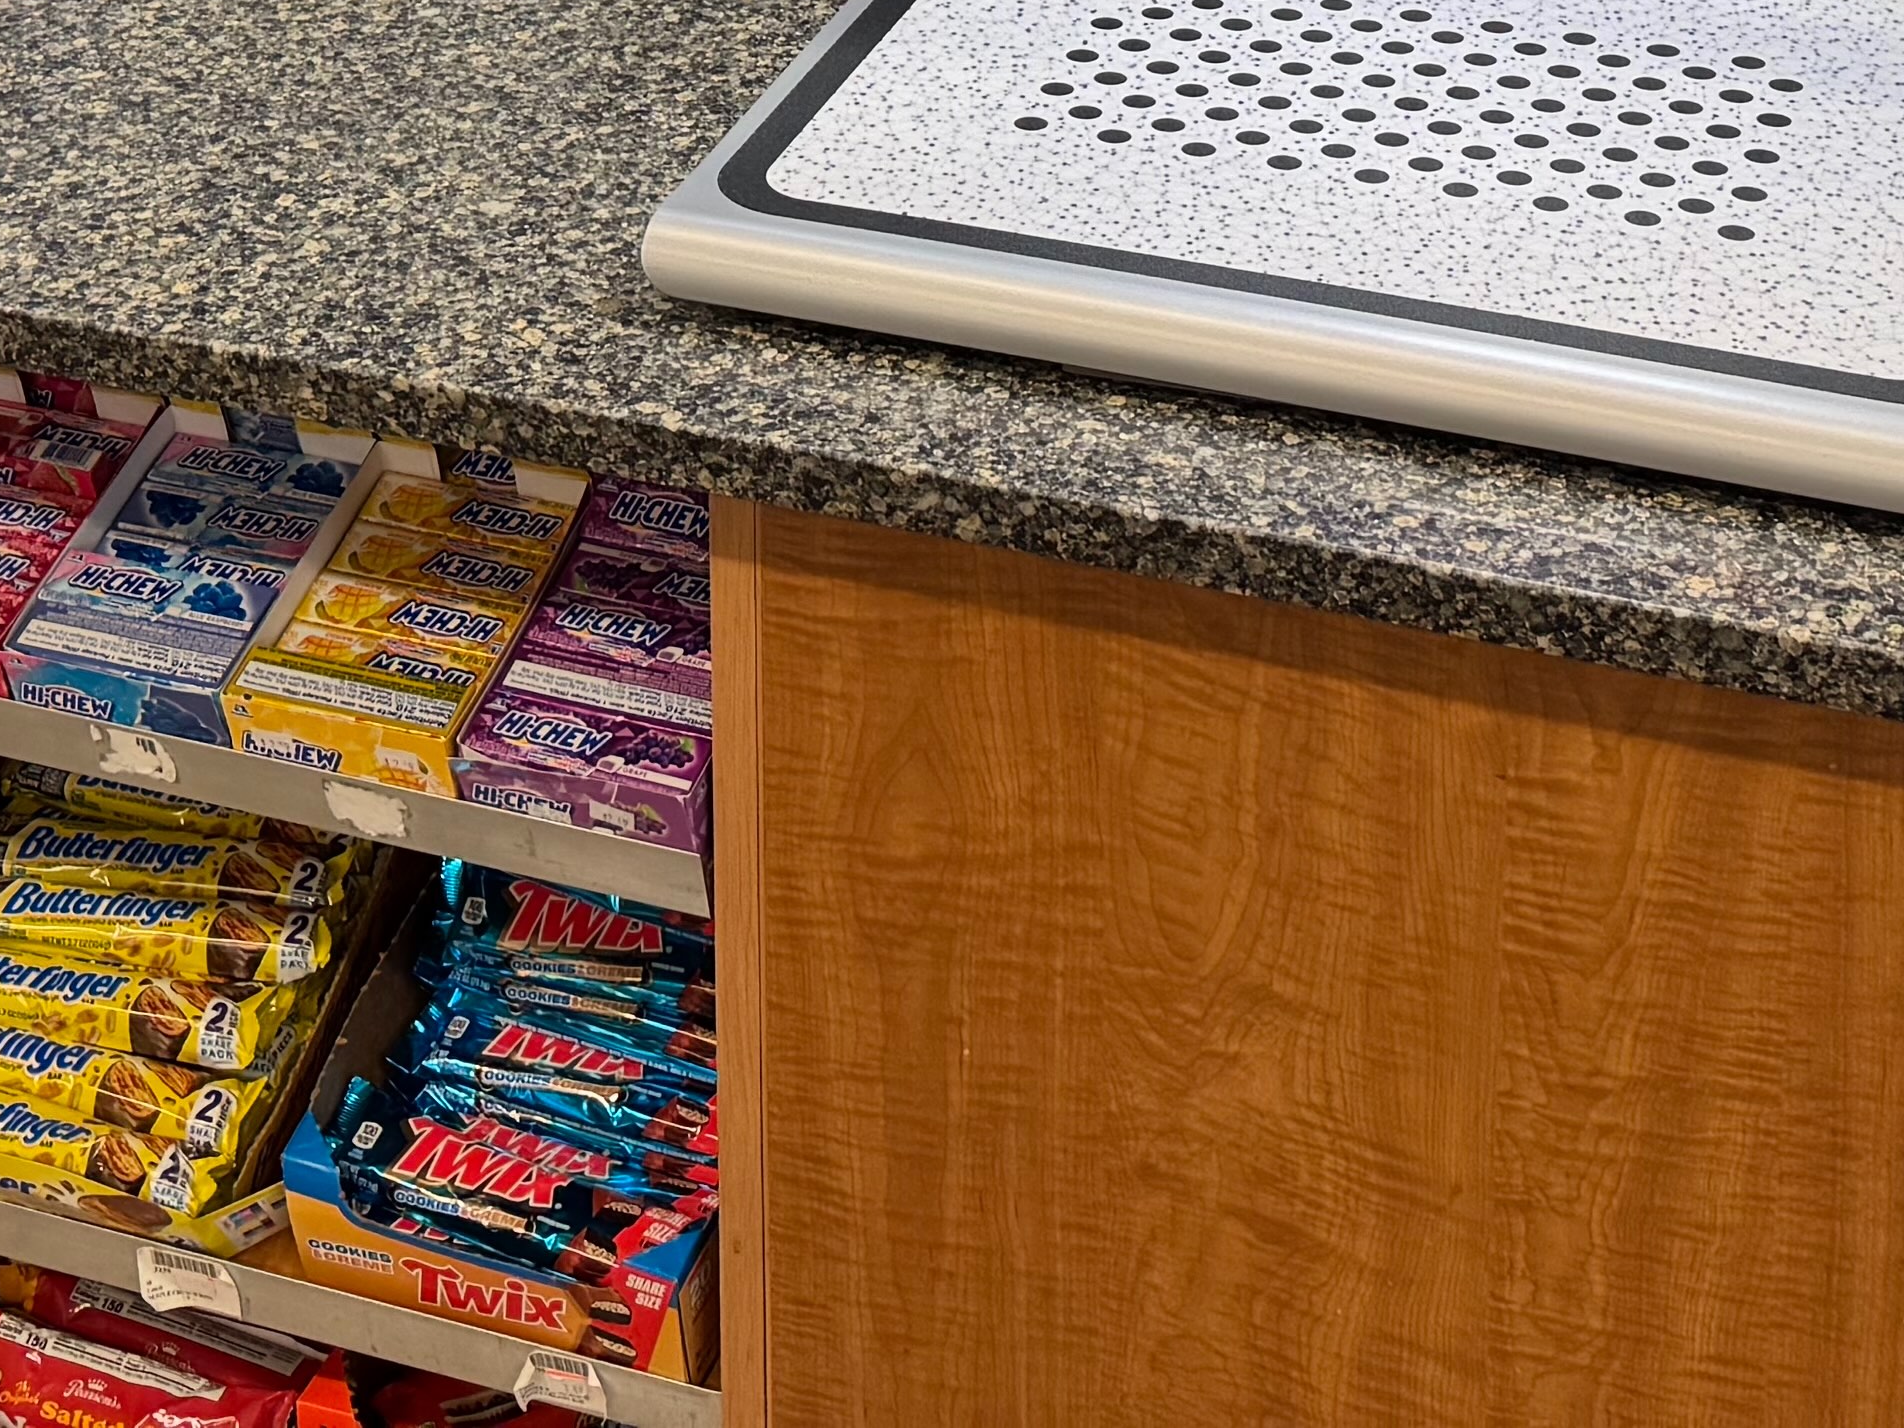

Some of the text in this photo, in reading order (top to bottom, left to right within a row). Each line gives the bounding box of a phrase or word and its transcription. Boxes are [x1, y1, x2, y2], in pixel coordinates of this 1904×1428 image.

[70, 565, 181, 602] HI-CHEW
[556, 604, 670, 647] HI-CHEW
[20, 684, 112, 719] HI-CHEW
[493, 710, 612, 754] HI-CHEW
[2, 879, 208, 925] Butterfinger
[390, 1116, 573, 1211] Twix
[399, 1257, 566, 1333] Twix
[626, 1272, 667, 1296] SHARE
[635, 1291, 663, 1312] SIZE
